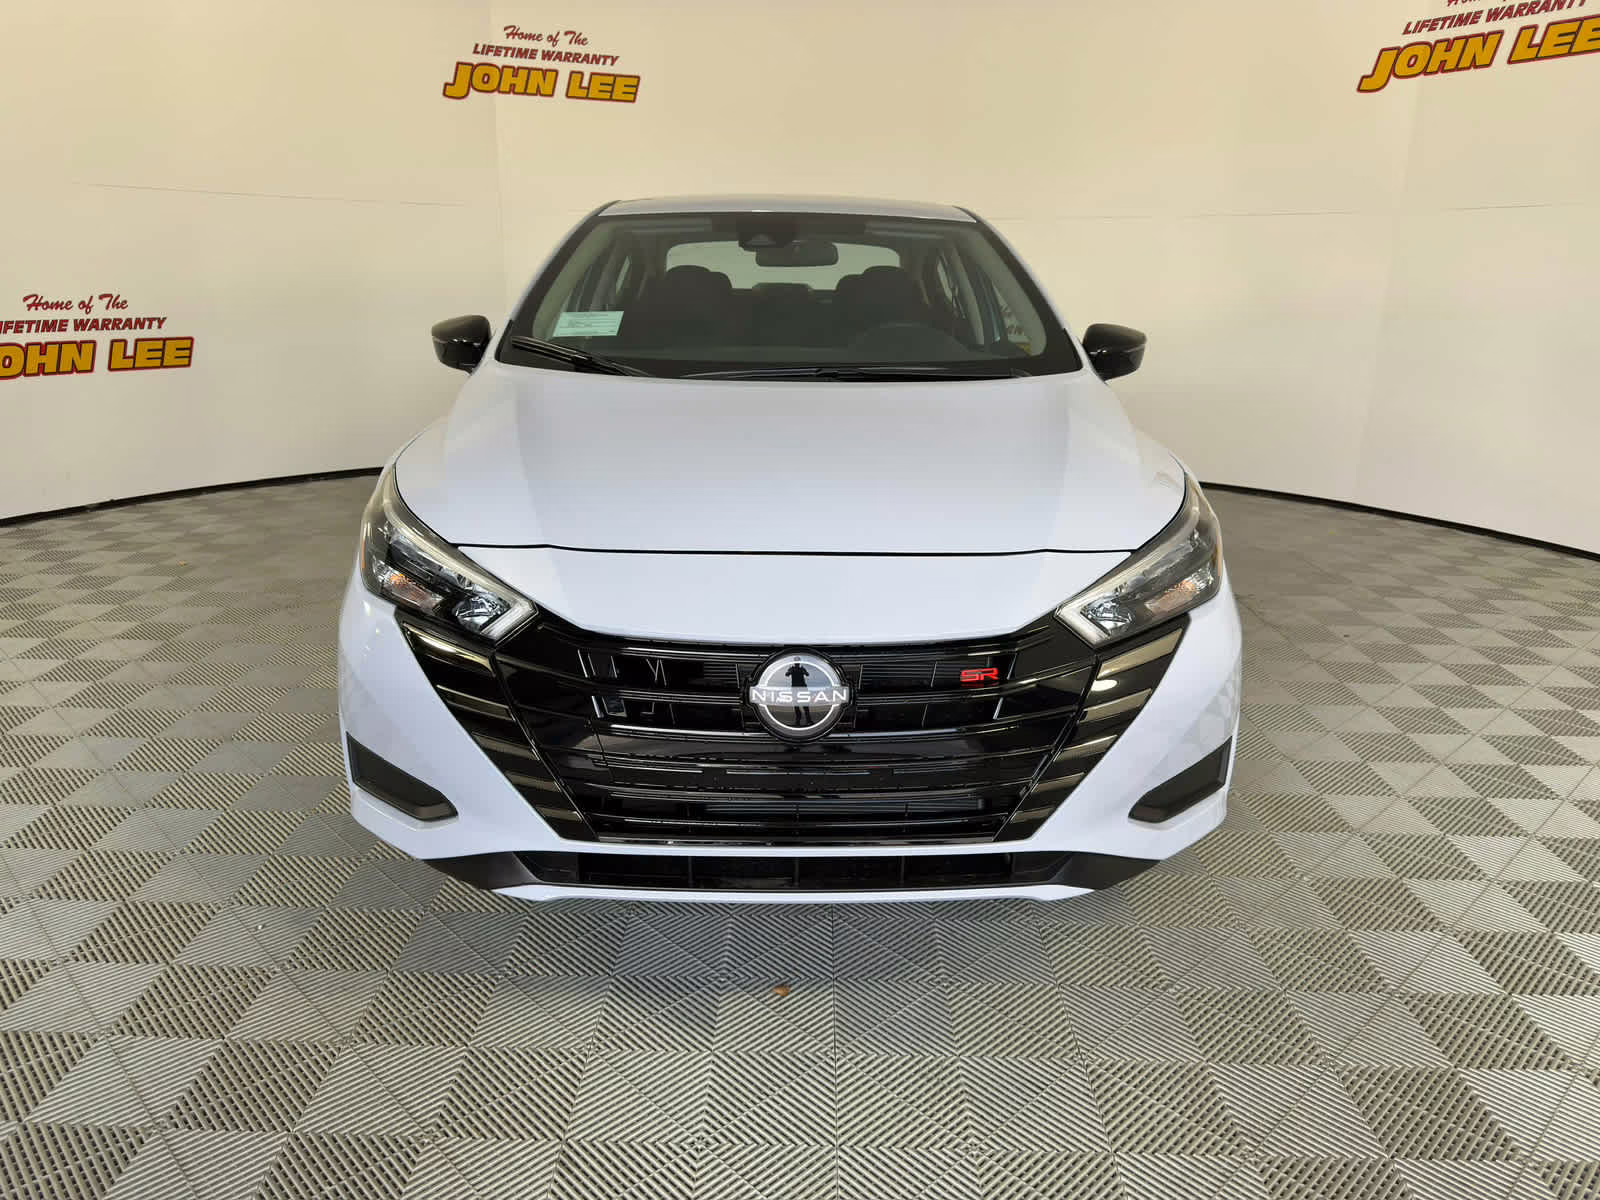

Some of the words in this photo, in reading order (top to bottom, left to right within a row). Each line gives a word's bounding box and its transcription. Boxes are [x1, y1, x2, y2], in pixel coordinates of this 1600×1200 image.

[1402, 10, 1482, 35] LIFETIME
[503, 25, 543, 42] Home
[546, 31, 560, 47] of
[564, 31, 588, 46] The
[472, 43, 538, 60] LIFETIME
[541, 50, 620, 66] WARRANTY
[1357, 30, 1504, 93] JOHN
[1507, 14, 1600, 64] LEE
[443, 62, 558, 99] JOHN
[566, 71, 640, 103] LEE
[23, 294, 73, 311] Home
[78, 296, 93, 315] of
[98, 294, 128, 310] The
[0, 319, 69, 334] IFETIME
[73, 317, 167, 332] WARRANTY
[0, 340, 96, 380] OHN
[108, 336, 194, 371] LEE
[959, 667, 999, 683] SR
[751, 687, 848, 703] NISSAN
